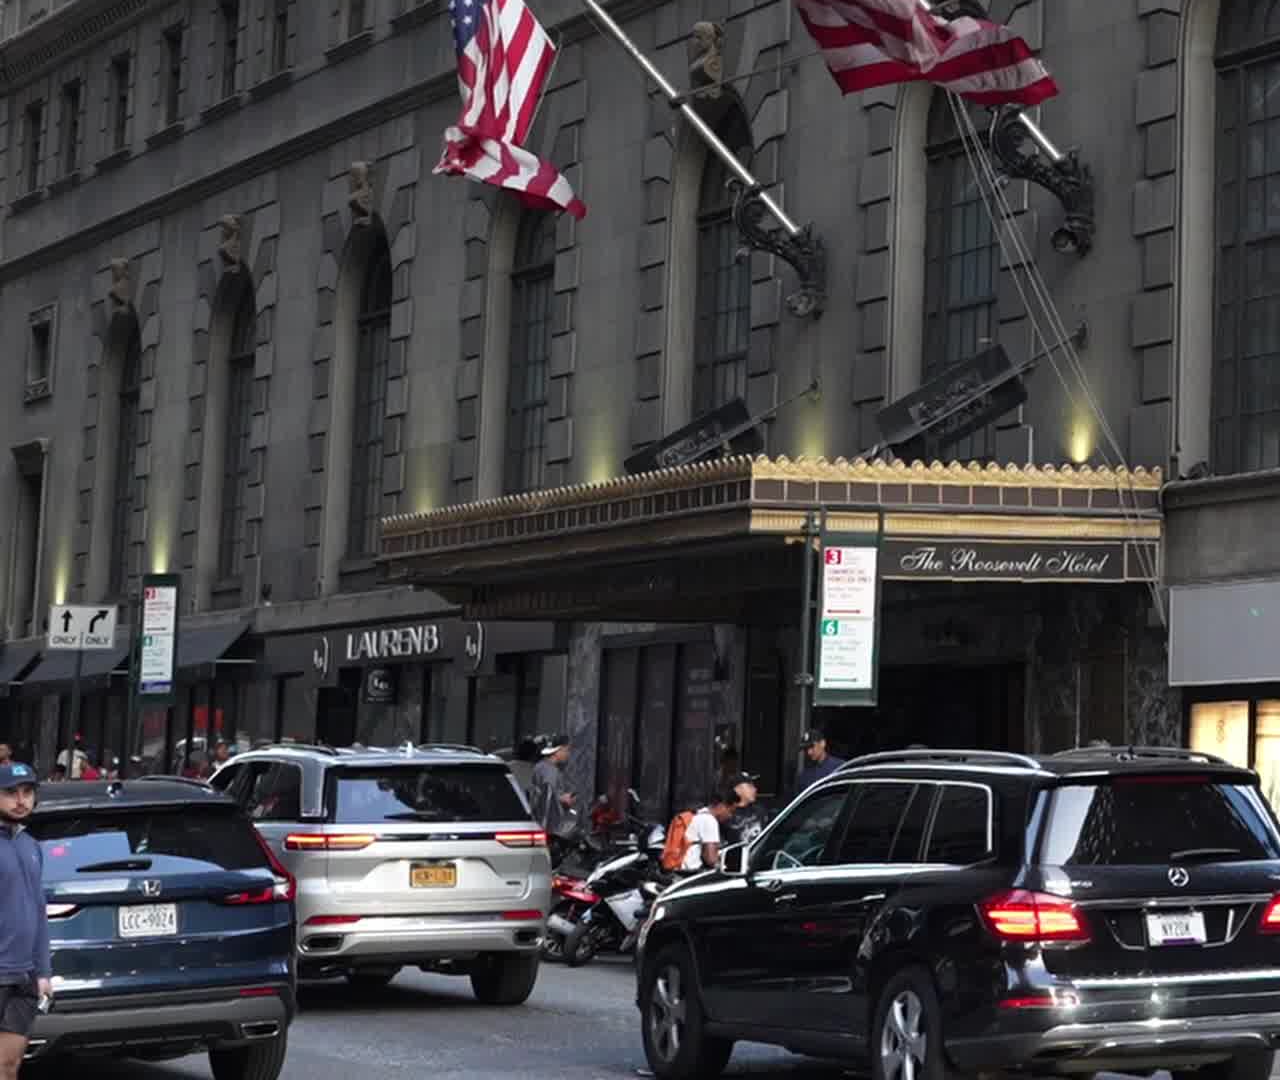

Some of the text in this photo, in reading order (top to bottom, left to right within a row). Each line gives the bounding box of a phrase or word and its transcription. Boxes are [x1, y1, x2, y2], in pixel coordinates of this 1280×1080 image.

[900, 546, 1110, 573] The Roosevelt Hotel
[51, 635, 78, 645] ONLY
